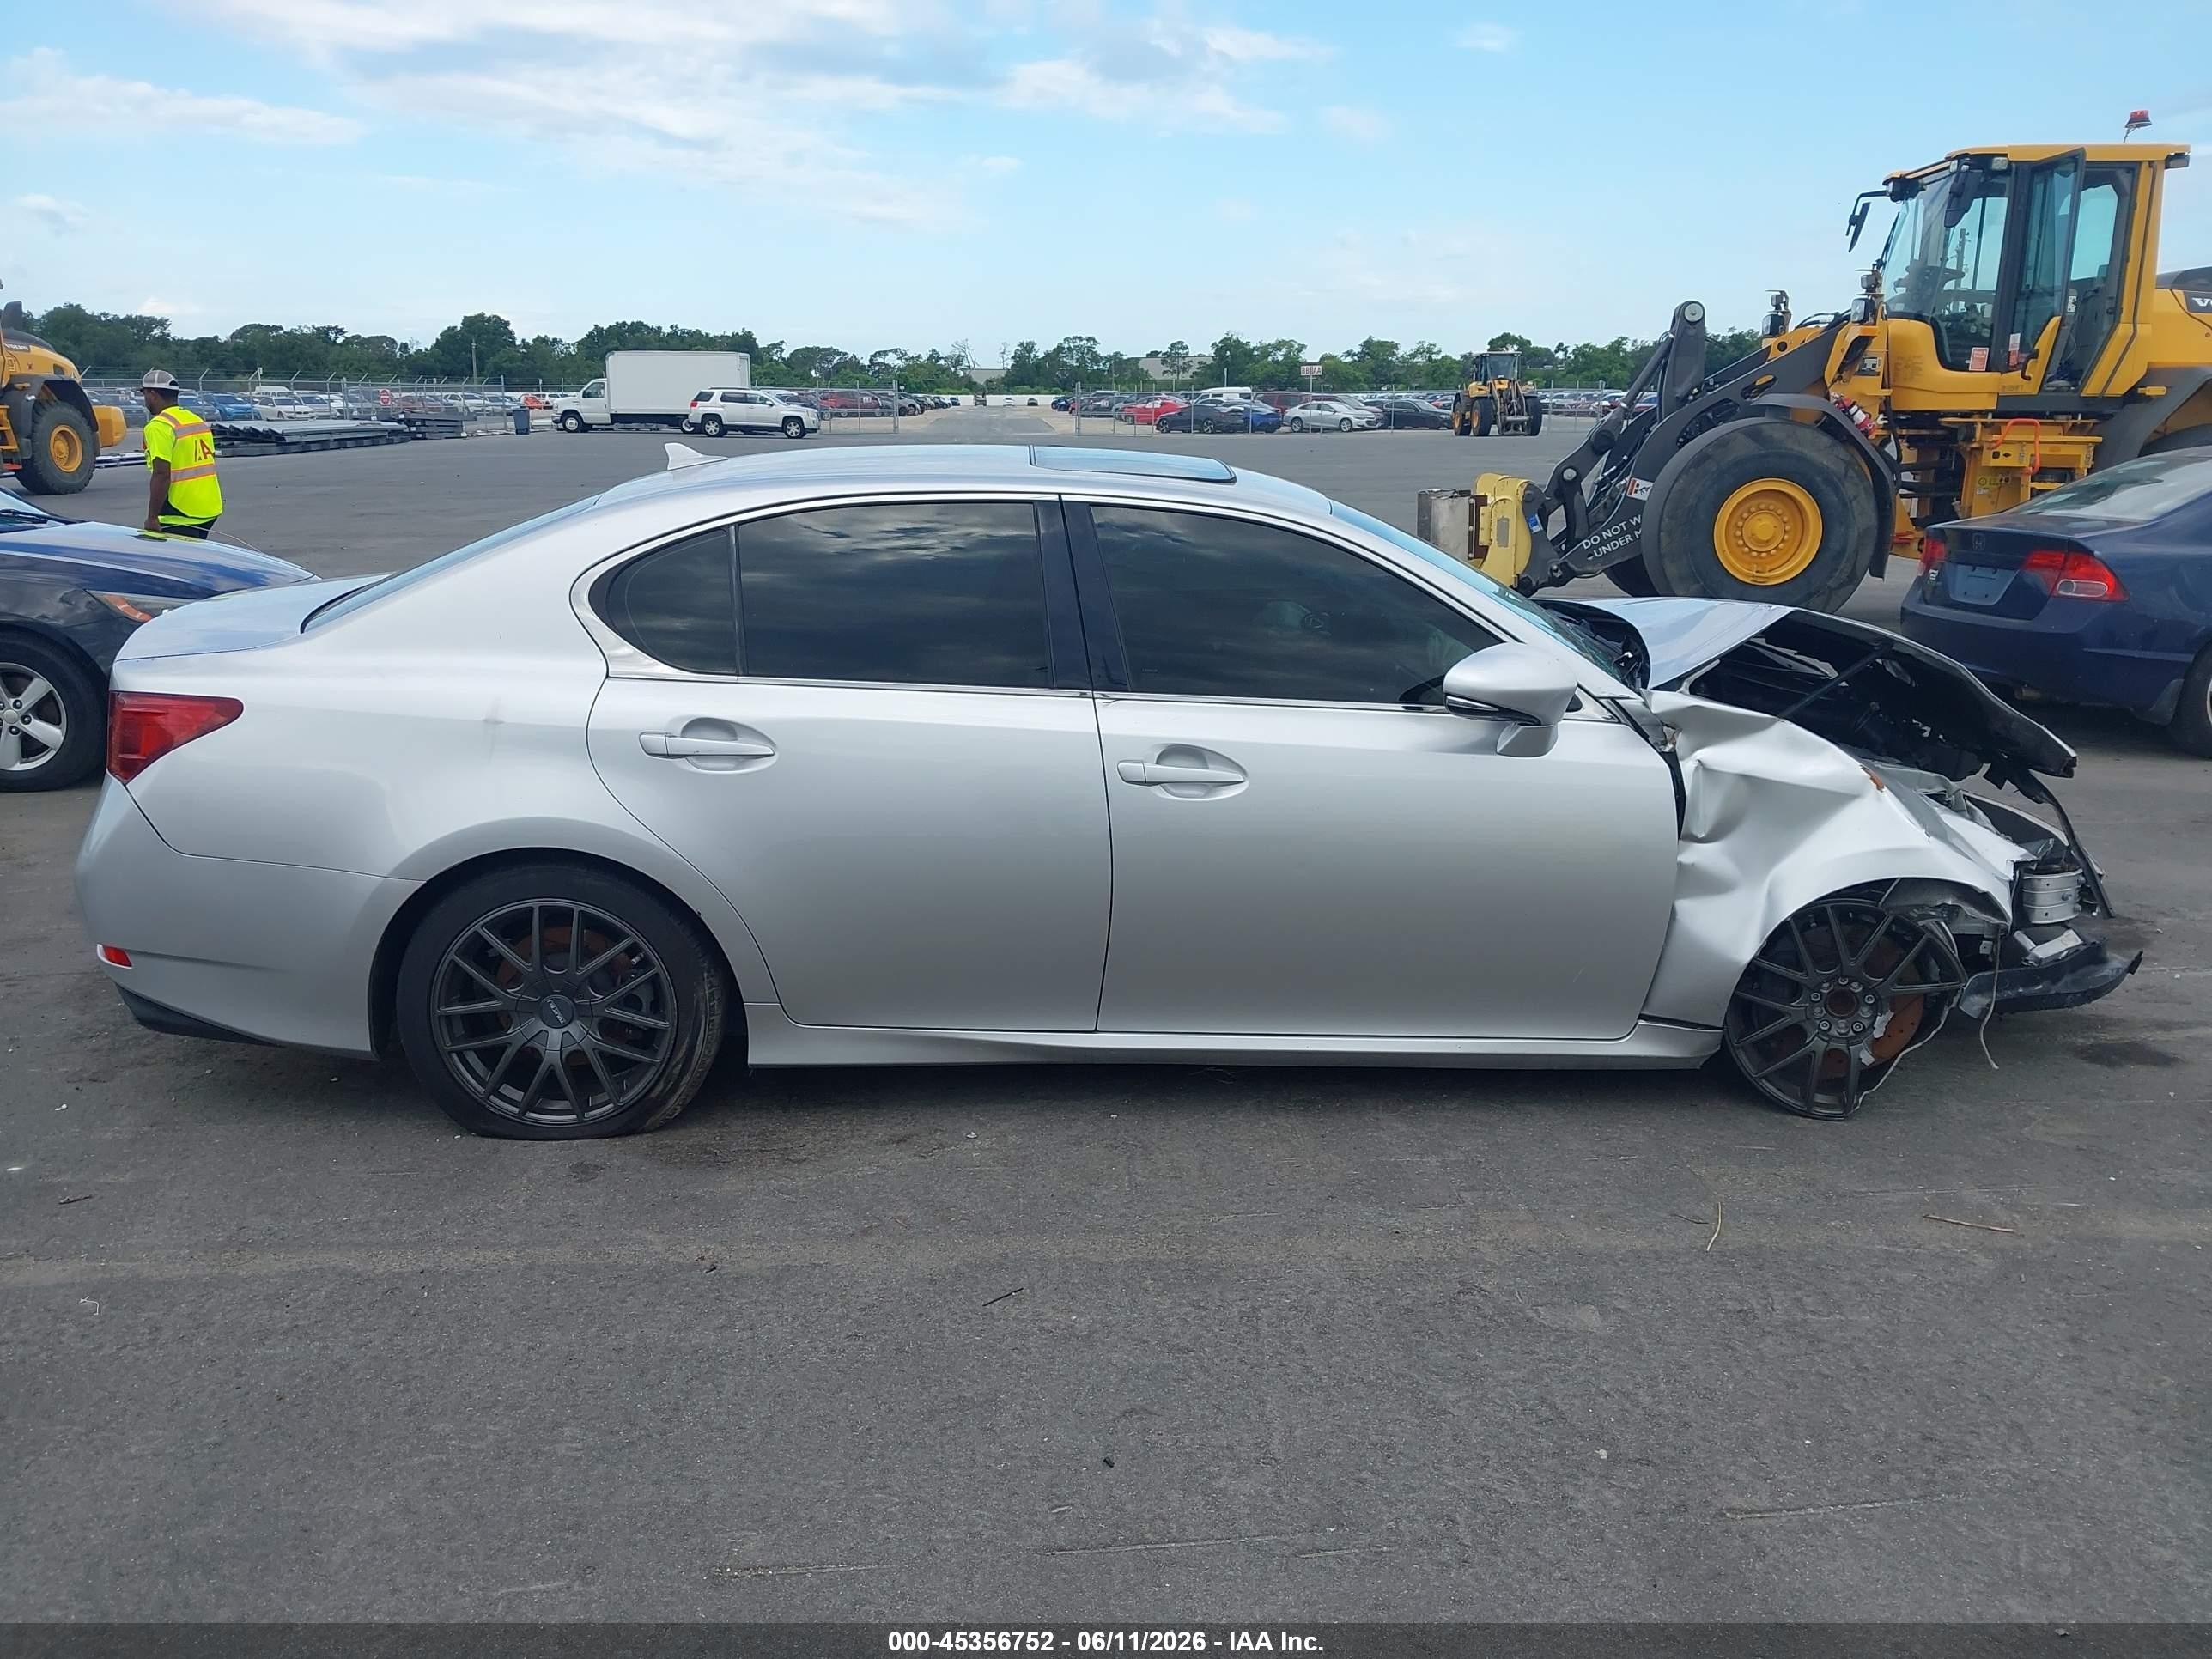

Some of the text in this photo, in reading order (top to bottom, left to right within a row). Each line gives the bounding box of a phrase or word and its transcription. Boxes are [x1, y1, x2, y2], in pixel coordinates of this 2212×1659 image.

[1582, 534, 1600, 550] DO
[1601, 521, 1627, 540] NOT
[1593, 533, 1633, 558] UNDER
